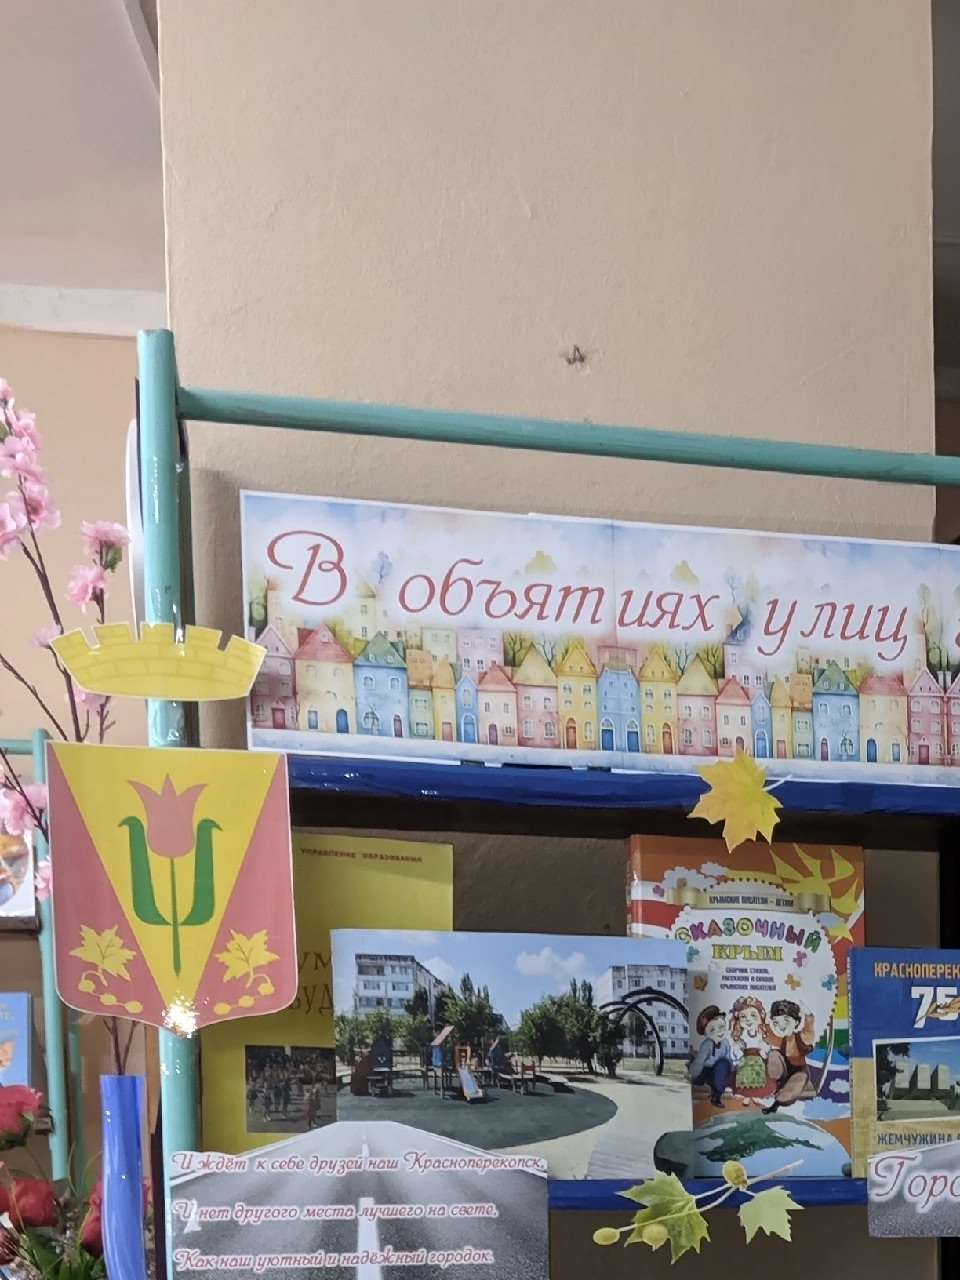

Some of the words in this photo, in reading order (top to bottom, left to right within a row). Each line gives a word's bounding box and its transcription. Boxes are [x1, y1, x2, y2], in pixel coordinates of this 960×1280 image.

[267, 529, 348, 606] В
[398, 557, 721, 632] объятиях
[300, 848, 357, 859] УПРАВЛЕНИЕ
[362, 852, 423, 863] ОБРАЗОВАНИЯ
[674, 917, 822, 954] СКАЗОЧНЫЙ
[711, 943, 784, 962] КРЫМ
[911, 986, 960, 1029] 75
[172, 1153, 194, 1171] И
[197, 1154, 247, 1173] ждёт
[256, 1160, 267, 1170] к
[271, 1156, 305, 1170] себе
[309, 1155, 362, 1174] друзей
[368, 1159, 399, 1169] наш
[403, 1152, 545, 1174] Красноперекопск,
[173, 1201, 194, 1219] И
[200, 1208, 229, 1219] нет
[235, 1205, 298, 1223] другого
[303, 1208, 354, 1218] места
[358, 1206, 424, 1221] лучшего
[428, 1206, 446, 1215] на
[451, 1205, 497, 1217] свете,
[174, 1250, 215, 1268] Как
[220, 1257, 250, 1267] наш
[257, 1254, 323, 1271] уютный
[327, 1256, 337, 1265] и
[342, 1248, 425, 1265] надёжный
